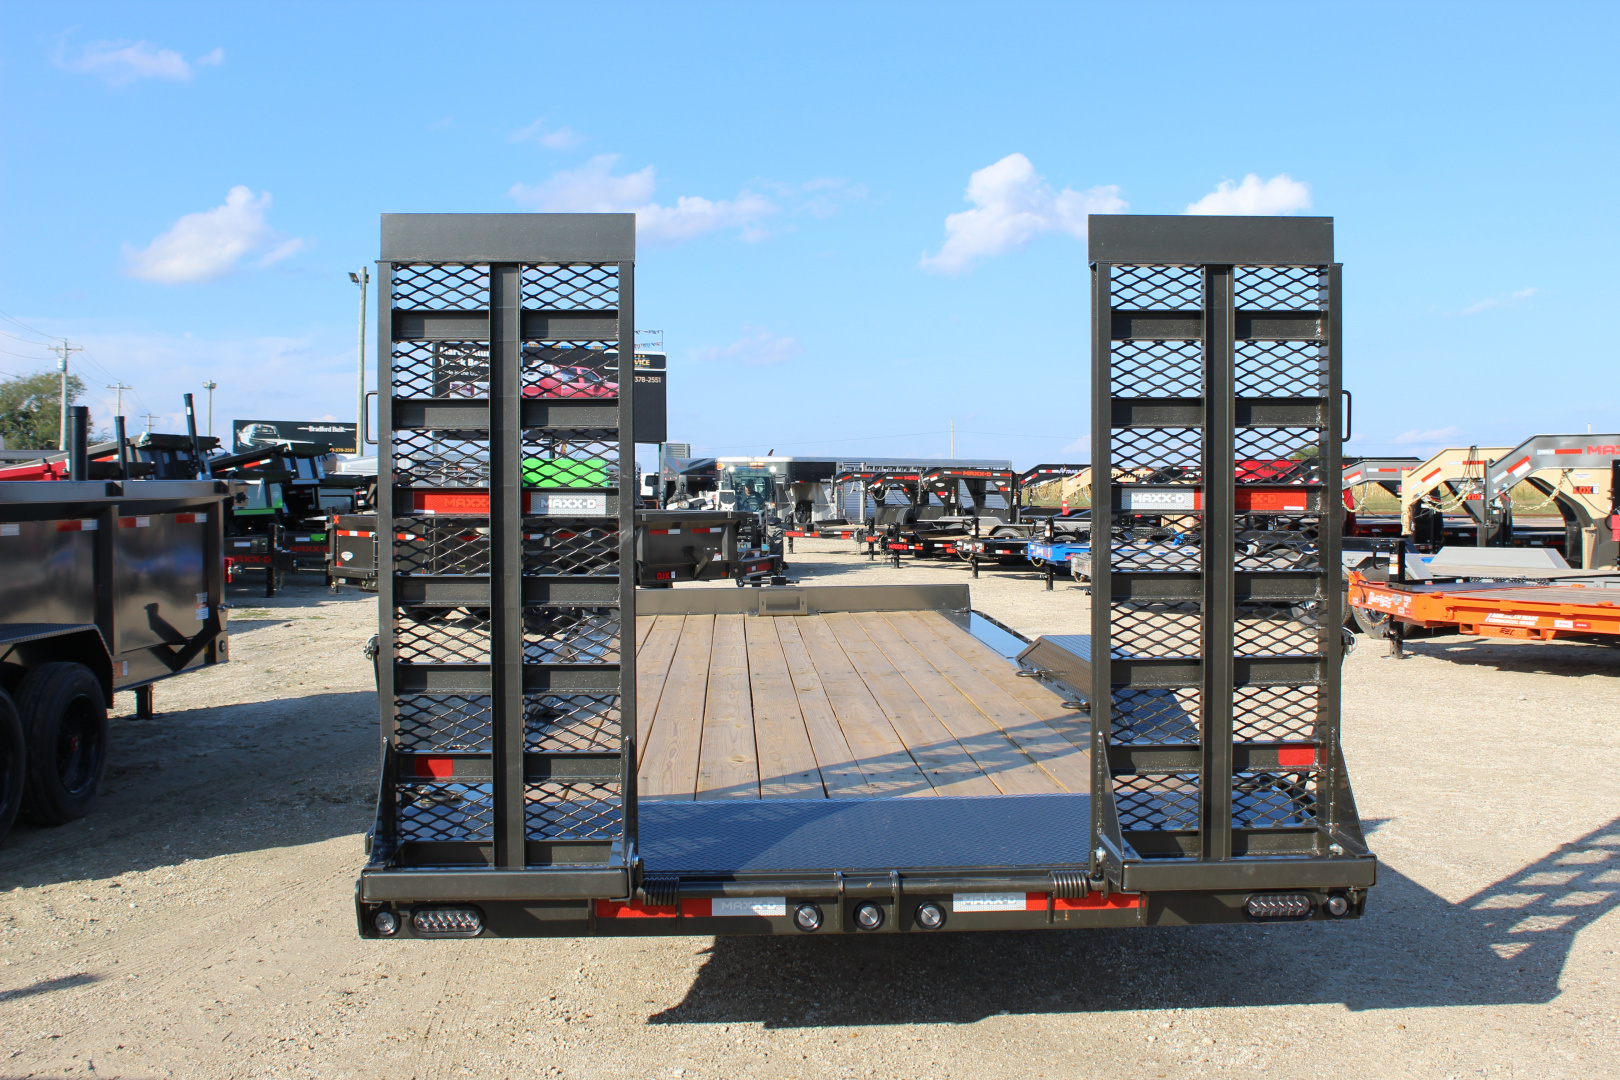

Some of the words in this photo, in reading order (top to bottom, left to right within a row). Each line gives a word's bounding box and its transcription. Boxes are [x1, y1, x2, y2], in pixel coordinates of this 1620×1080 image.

[540, 498, 596, 508] MAXX-D
[1132, 493, 1185, 504] MAXX-D
[721, 901, 777, 910] MAXX-D
[962, 895, 1017, 906] MAXX-D
